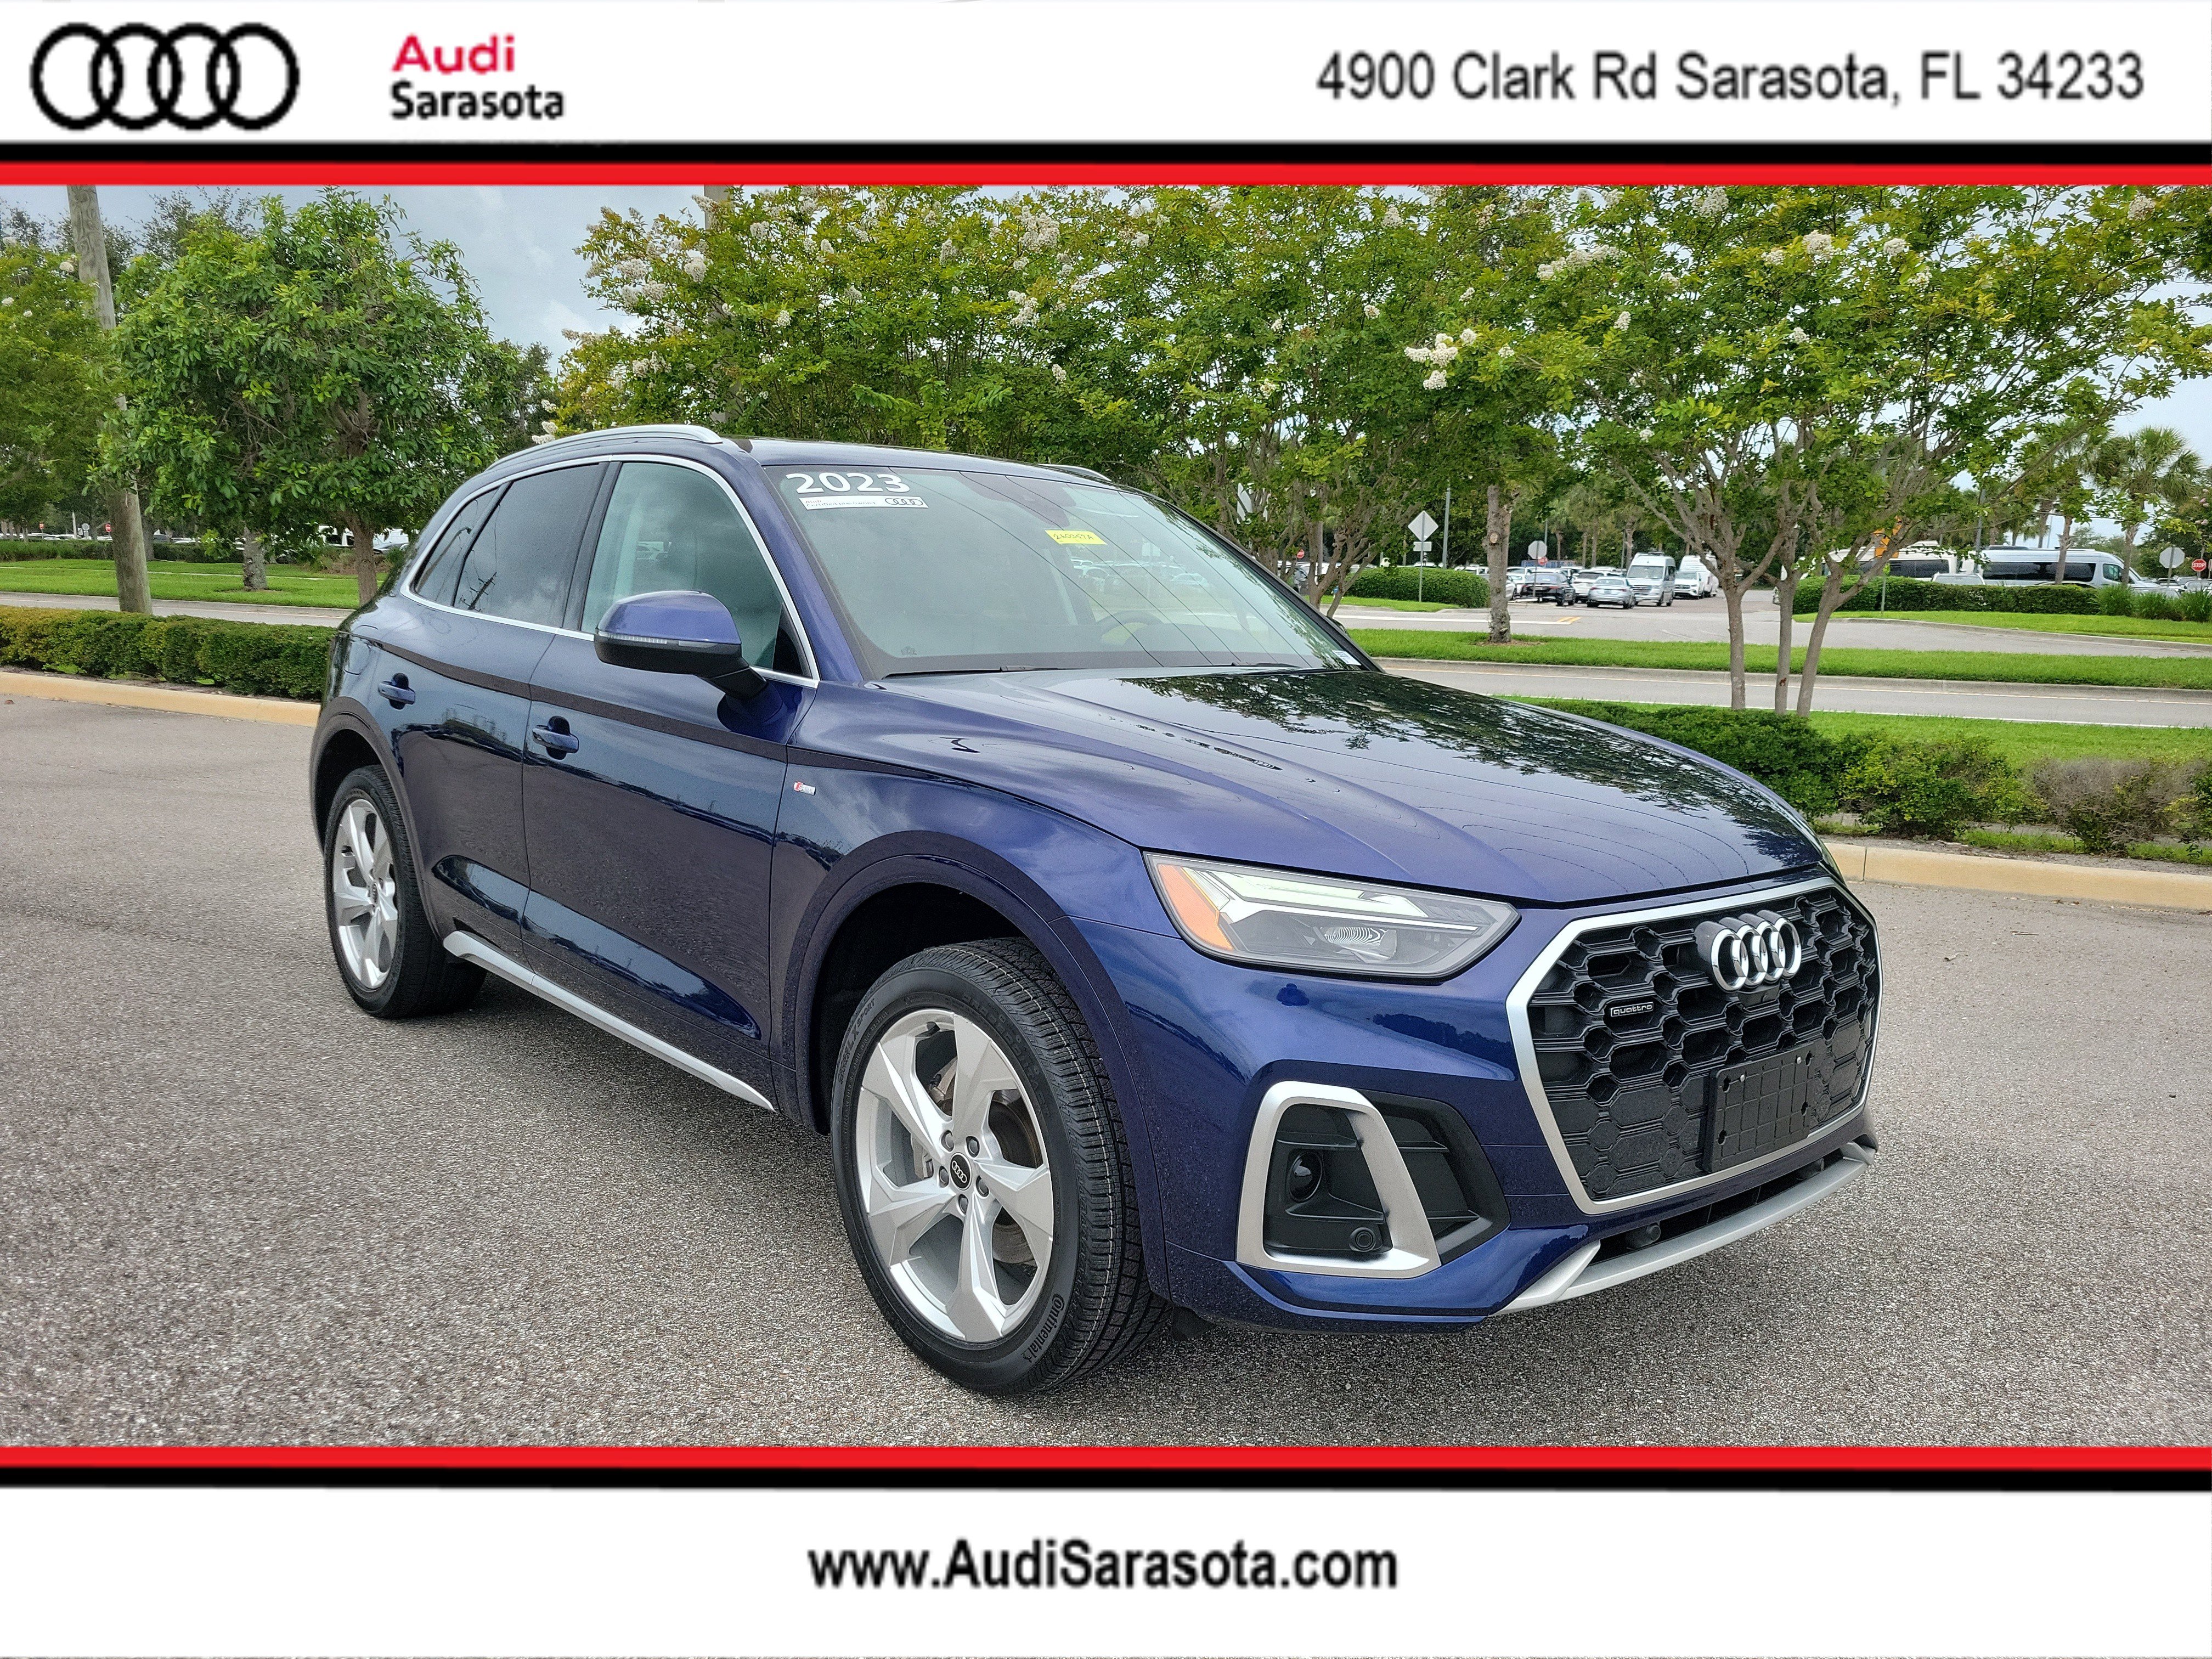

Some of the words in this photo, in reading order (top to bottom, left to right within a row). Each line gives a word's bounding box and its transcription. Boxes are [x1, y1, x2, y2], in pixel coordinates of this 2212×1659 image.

[786, 472, 910, 493] 2023
[856, 997, 876, 1028] SPORT
[1613, 1005, 1653, 1015] quattro
[1026, 1294, 1065, 1359] Continental
